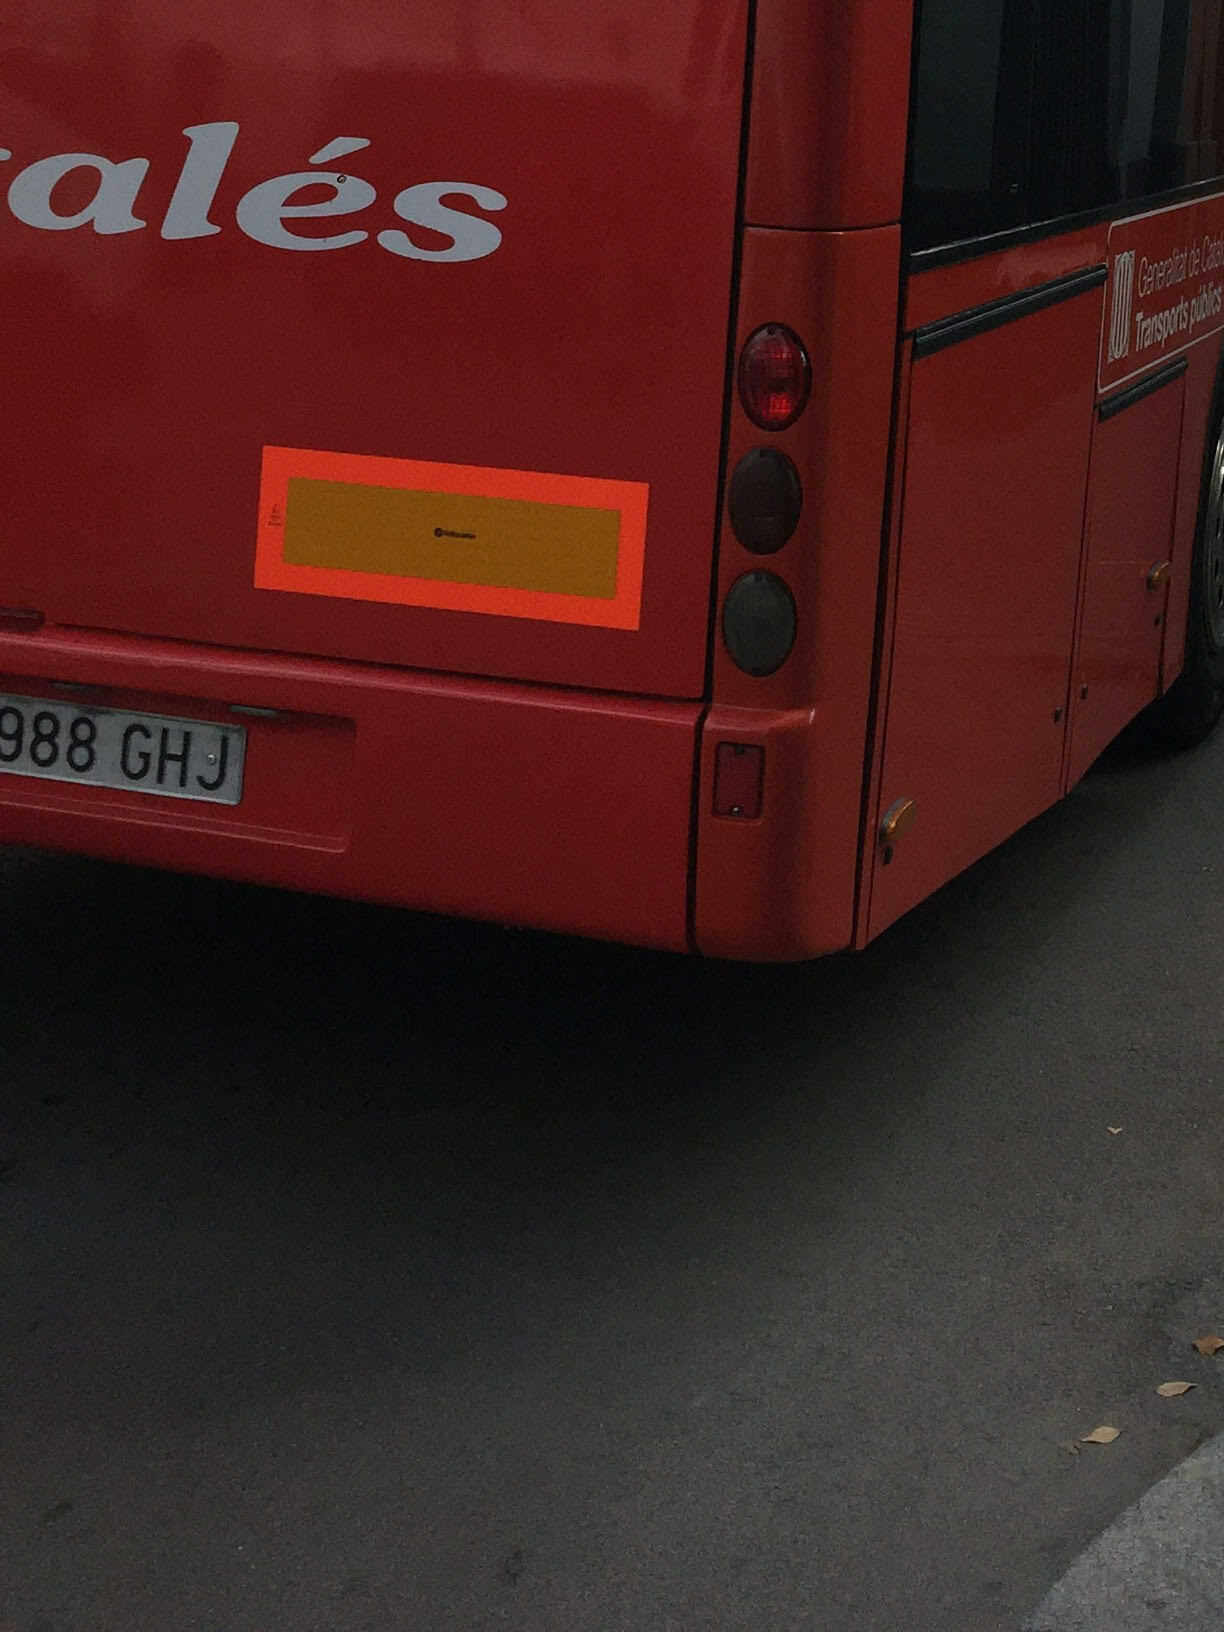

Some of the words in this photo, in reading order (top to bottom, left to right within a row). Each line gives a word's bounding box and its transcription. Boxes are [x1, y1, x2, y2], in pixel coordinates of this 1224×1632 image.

[0, 121, 508, 263] alés
[1135, 296, 1189, 352] Transports
[1188, 280, 1223, 334] públics
[120, 723, 229, 791] GHJ
